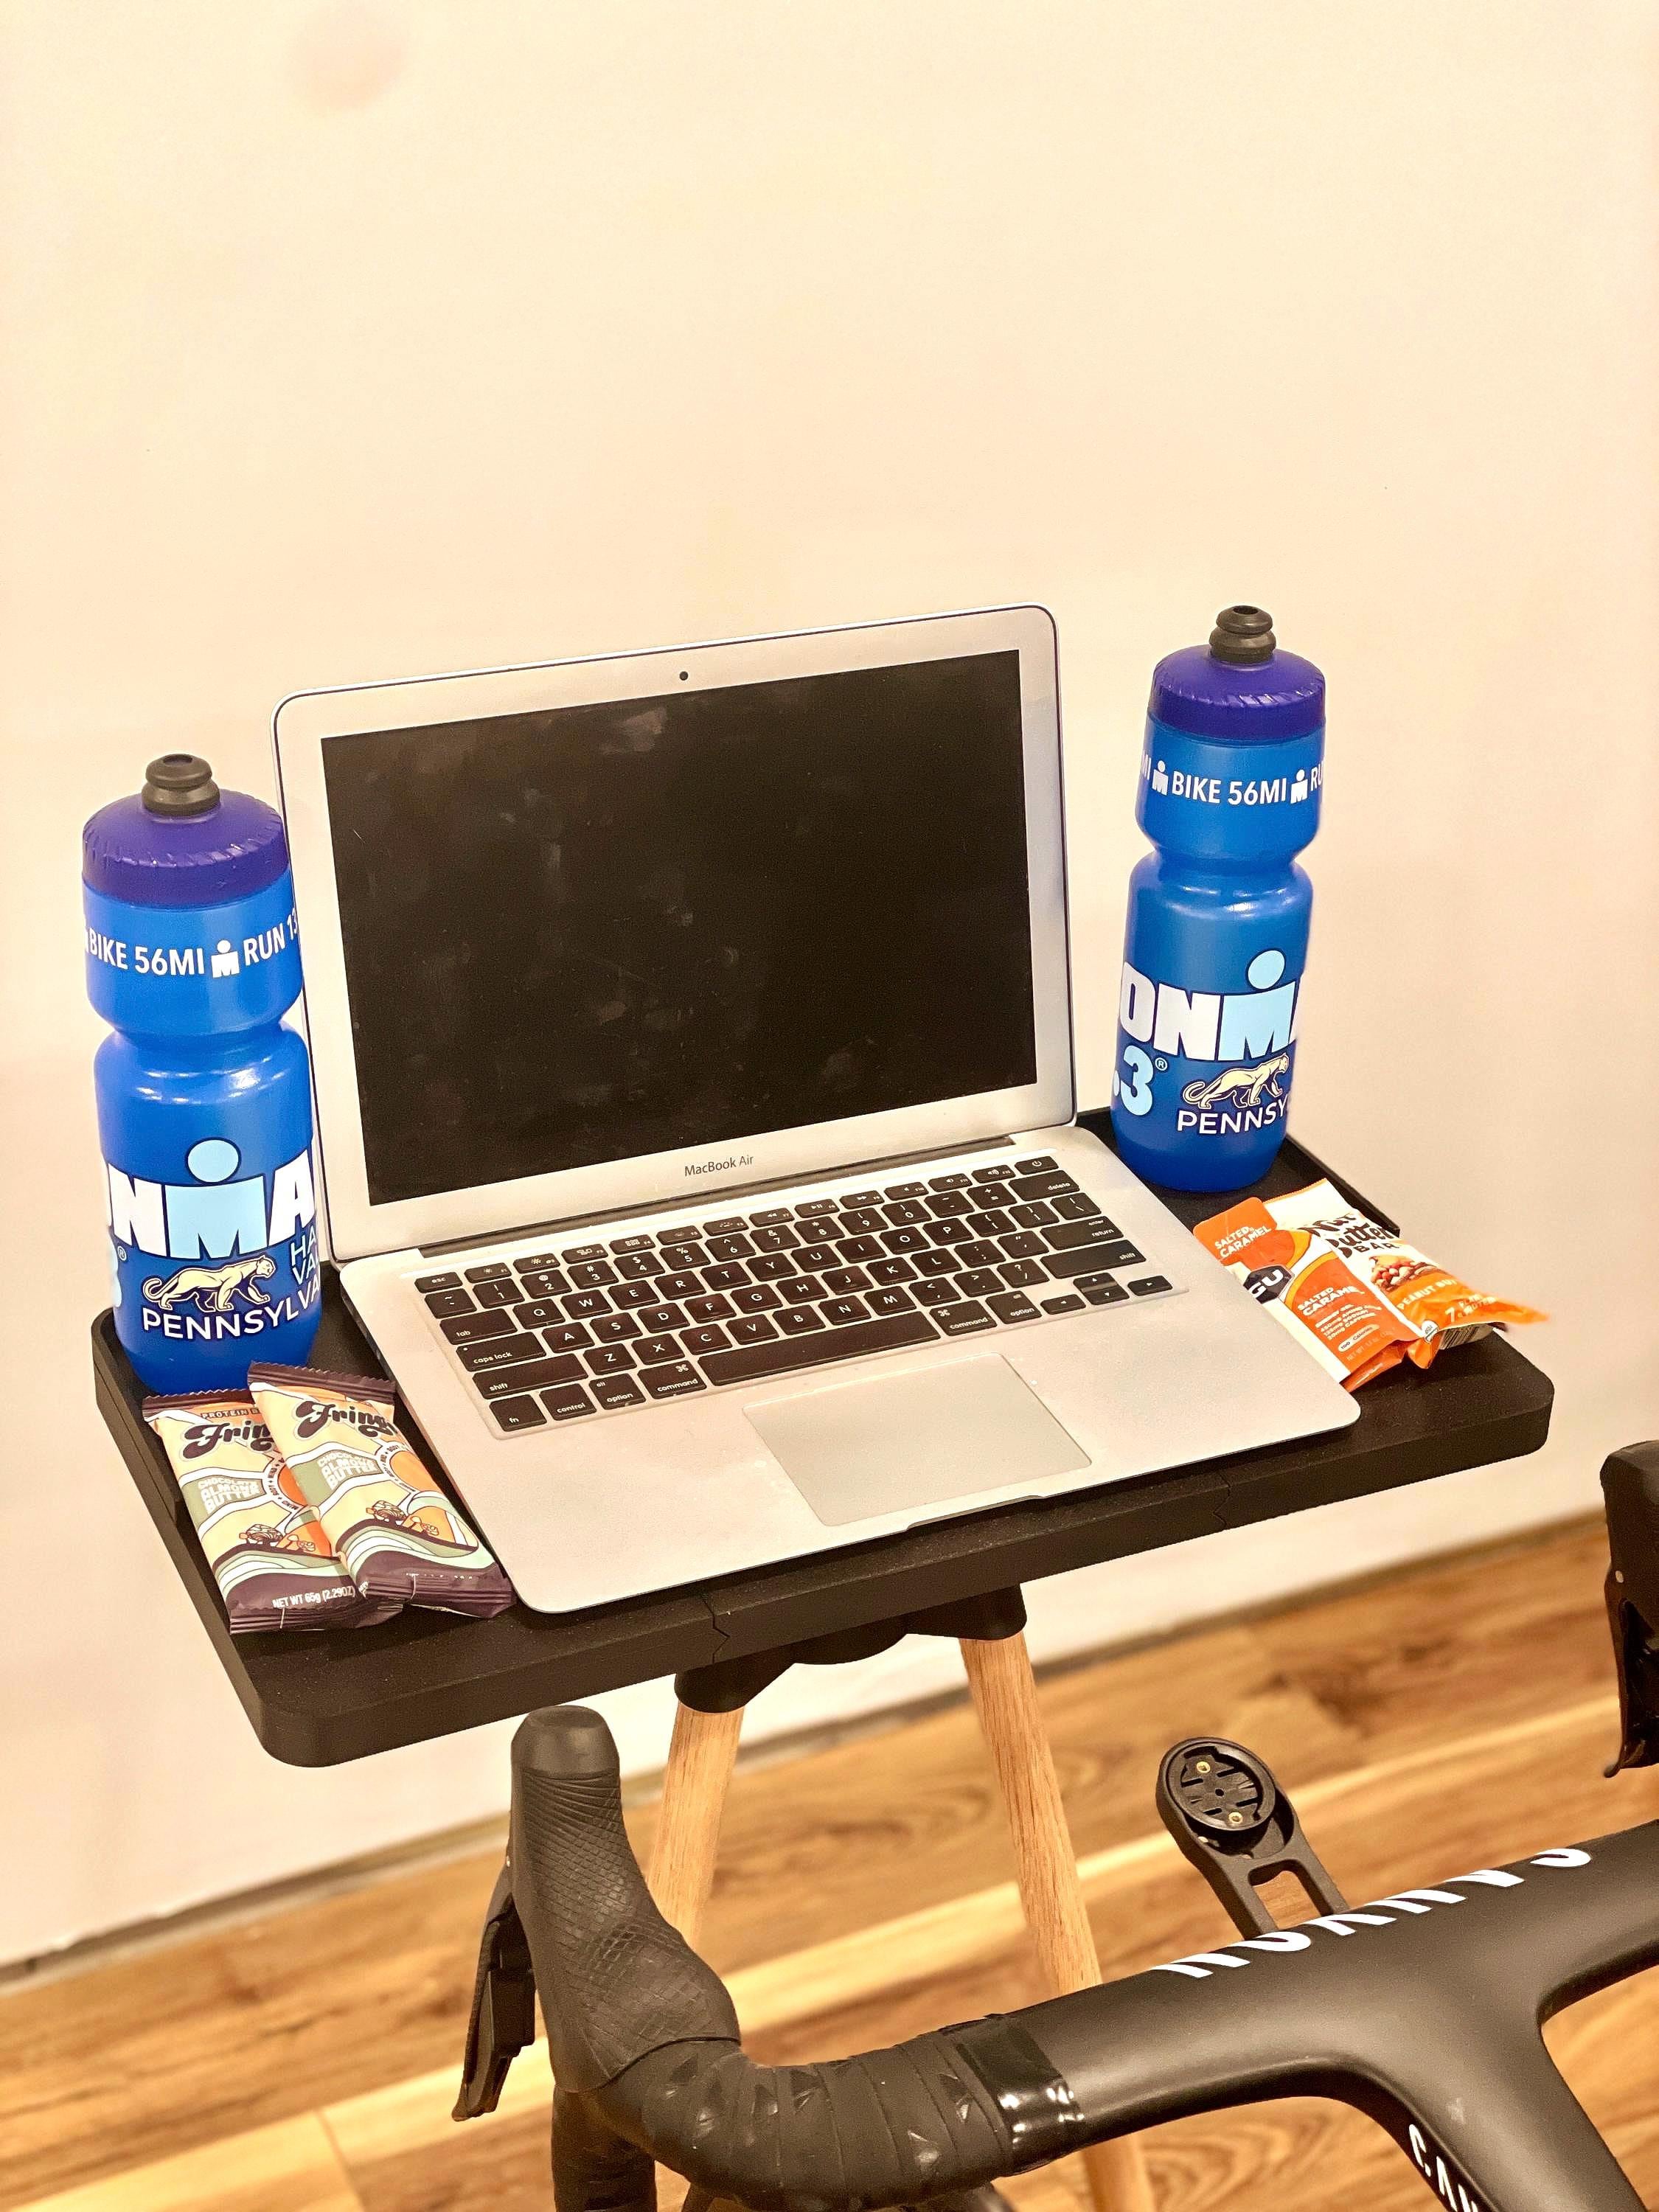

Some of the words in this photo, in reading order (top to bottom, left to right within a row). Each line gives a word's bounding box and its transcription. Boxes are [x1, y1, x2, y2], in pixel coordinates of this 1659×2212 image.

[1172, 771, 1222, 804] BIKE
[1227, 778, 1287, 805] 56MI
[88, 929, 128, 970] BIKE
[135, 947, 205, 975] 56MI
[243, 922, 286, 964] RUN
[684, 1157, 737, 1177] MacBook
[739, 1155, 754, 1166] Air
[1091, 1228, 1114, 1237] return
[1214, 1225, 1251, 1250] SALTED
[1220, 1225, 1272, 1258] CARAMEL
[1353, 1242, 1399, 1253] BAR
[1248, 1269, 1284, 1299] GU
[579, 1298, 593, 1307] W
[883, 1295, 897, 1304] M
[1298, 1287, 1335, 1311] SALTED
[1397, 1285, 1436, 1310] PEANUT
[1010, 1307, 1034, 1317] option
[950, 1317, 988, 1329] command
[456, 1329, 470, 1338] tab
[473, 1355, 494, 1364] caps
[495, 1352, 512, 1360] lock
[604, 1354, 616, 1362] Z
[489, 1382, 509, 1391] shift
[657, 1379, 698, 1392] command
[606, 1392, 634, 1403] option
[201, 1408, 249, 1419] PROTEIN
[557, 1402, 585, 1413] control
[204, 1490, 260, 1514] BUTTER
[272, 1596, 289, 1608] NET
[289, 1593, 304, 1606] WT
